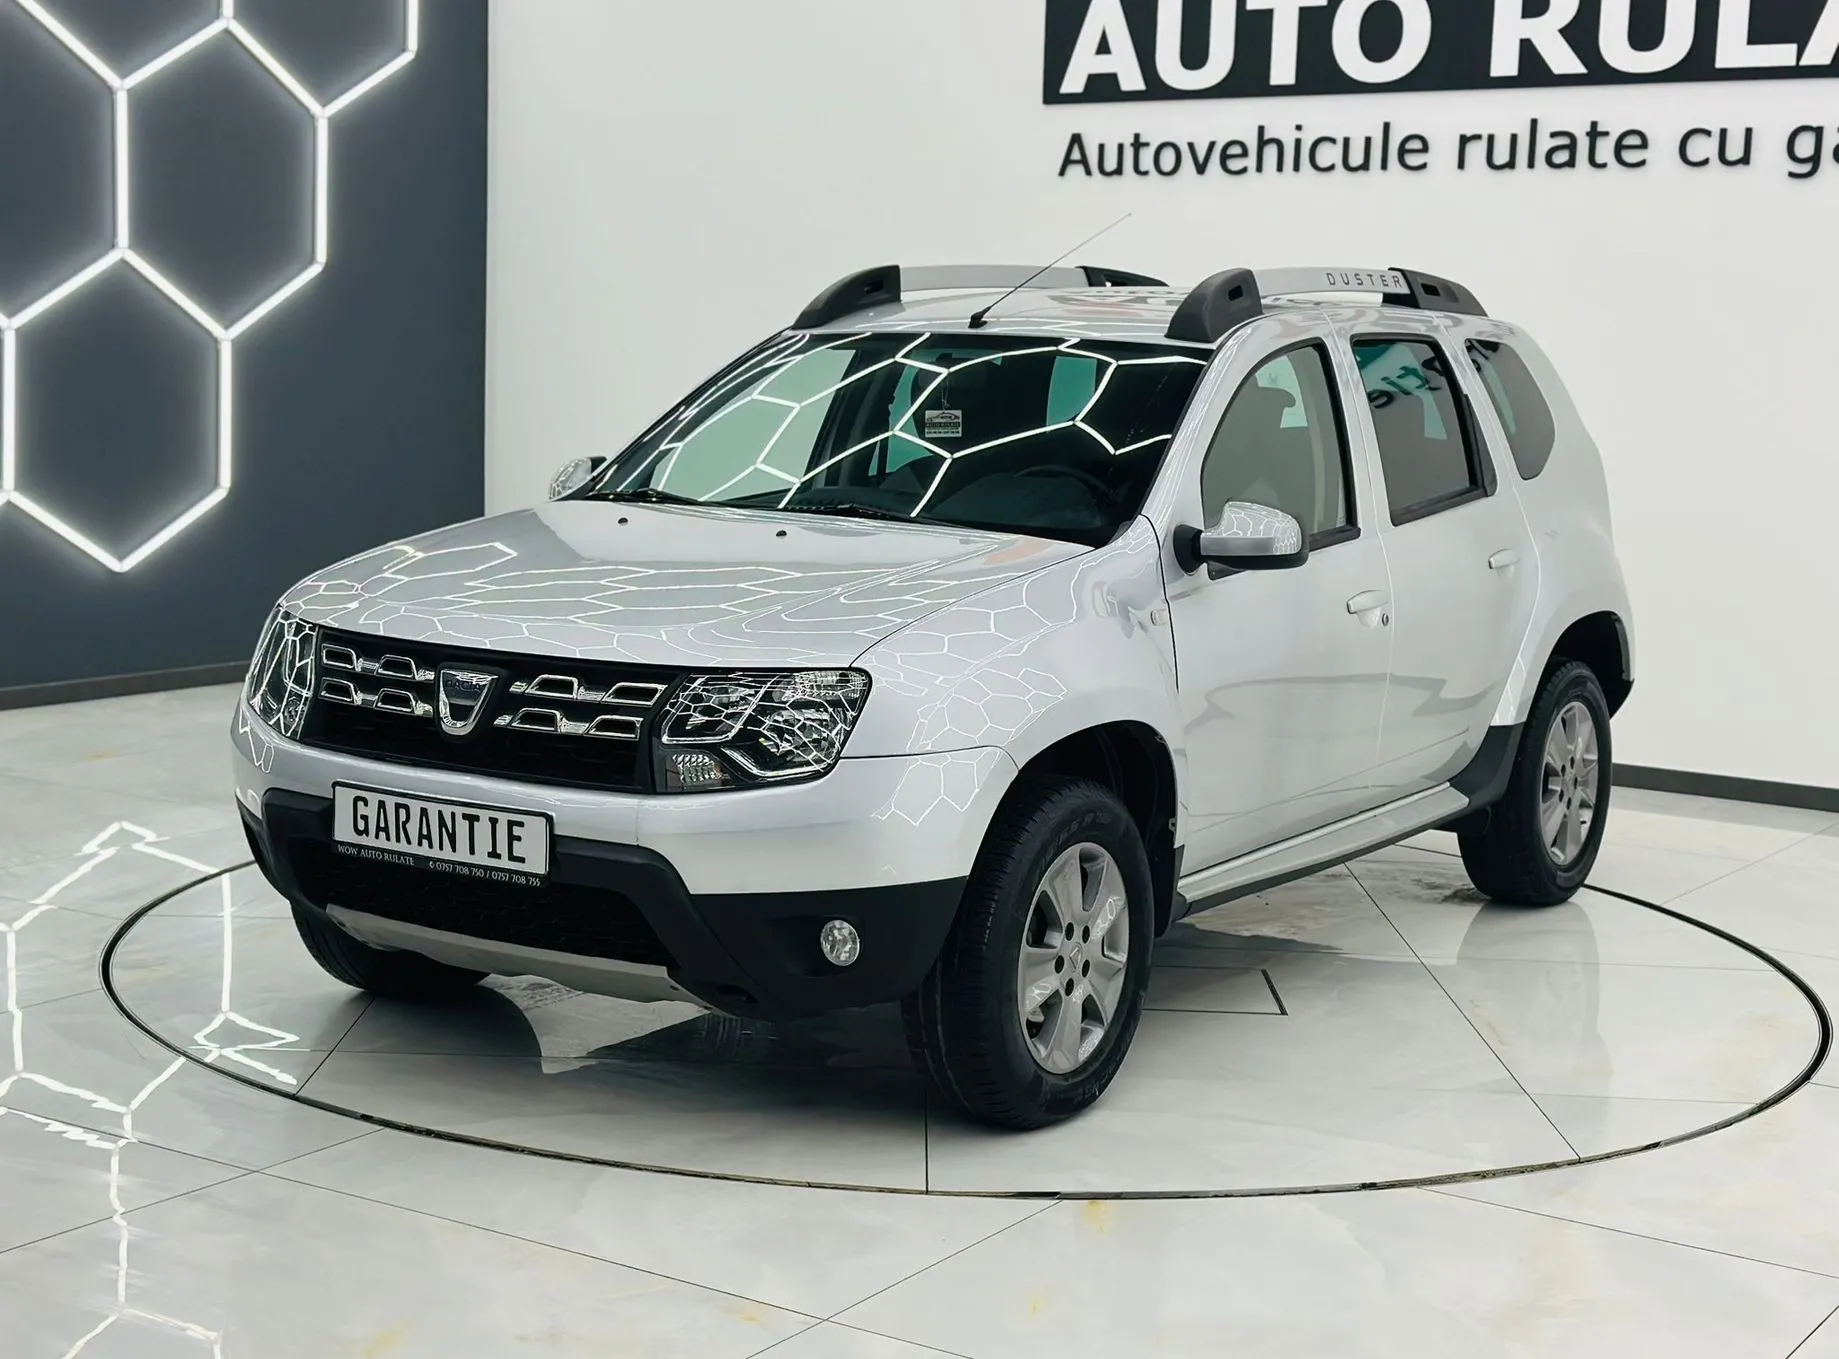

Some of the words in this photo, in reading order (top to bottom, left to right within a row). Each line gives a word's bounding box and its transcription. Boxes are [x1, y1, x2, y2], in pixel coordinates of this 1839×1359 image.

[1058, 0, 1433, 95] AUTO
[1058, 121, 1430, 178] Autovehicule
[1456, 117, 1649, 171] rulate
[1678, 126, 1753, 168] cu
[1786, 124, 1839, 179] g
[1326, 272, 1402, 288] DUSTER
[352, 795, 526, 864] GARANTIE
[337, 844, 357, 855] WOW
[360, 849, 382, 860] AUTO
[384, 853, 415, 866] RULATE
[491, 871, 510, 882] 0757
